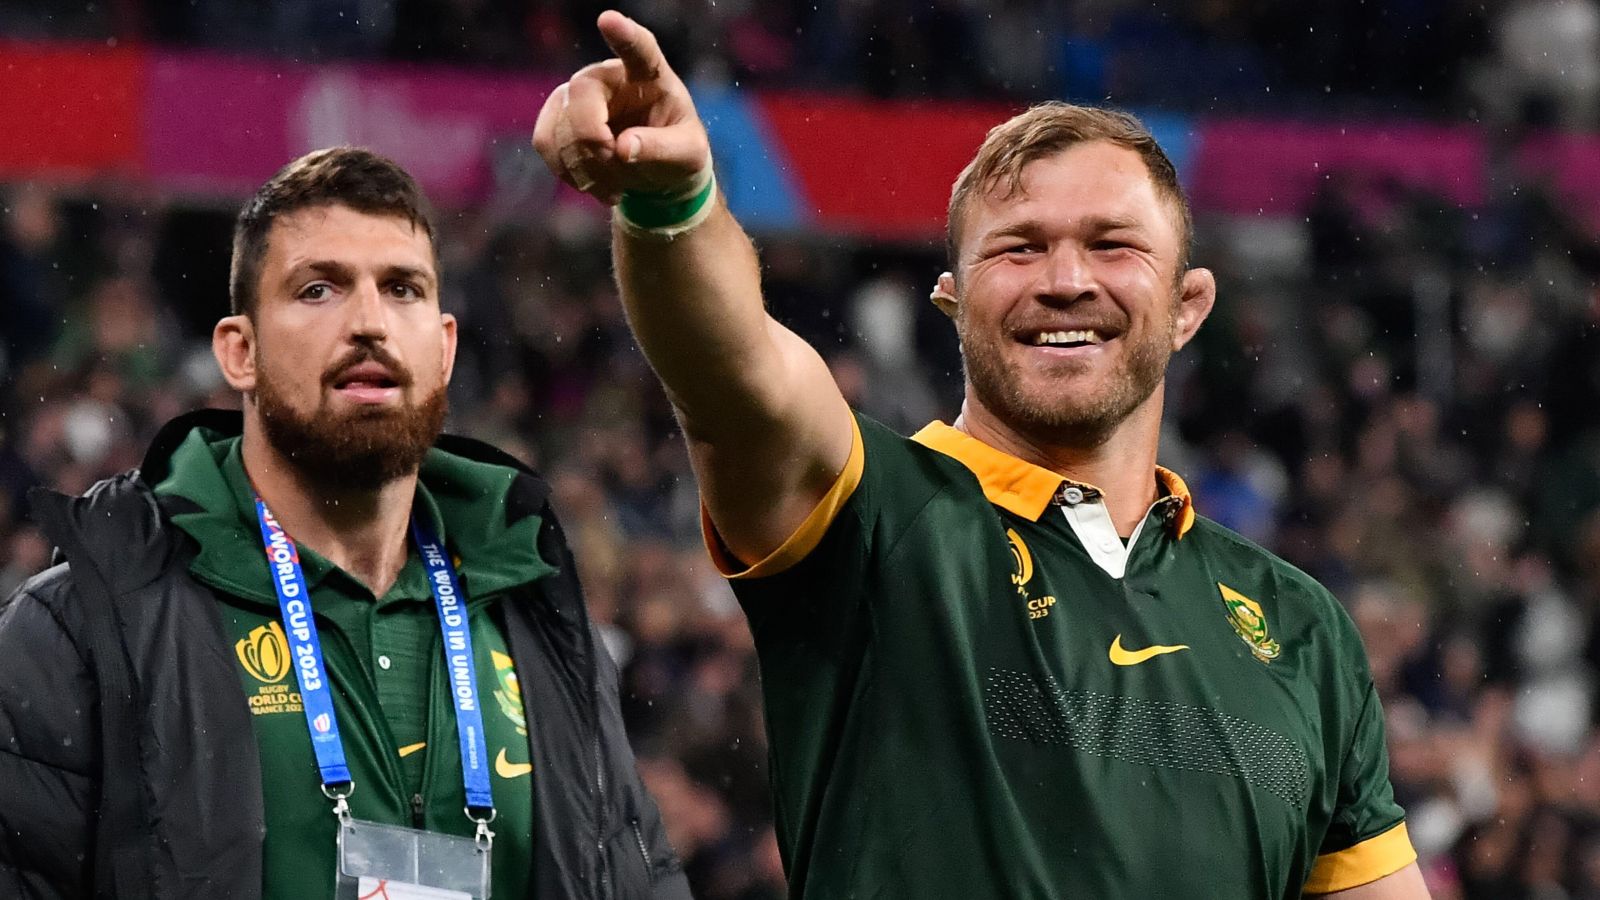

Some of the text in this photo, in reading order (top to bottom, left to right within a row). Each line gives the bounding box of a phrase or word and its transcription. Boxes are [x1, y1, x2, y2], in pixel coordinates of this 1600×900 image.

[270, 531, 299, 597] WORLD
[423, 544, 445, 567] THE
[433, 569, 462, 627] WORLD
[1028, 596, 1056, 610] CUP
[286, 600, 310, 641] CUP
[1029, 608, 1048, 619] 023
[447, 631, 466, 650] IN
[296, 643, 321, 691] 2023
[259, 684, 289, 694] RUGBY
[452, 655, 475, 711] UNION
[250, 704, 284, 715] RANCE
